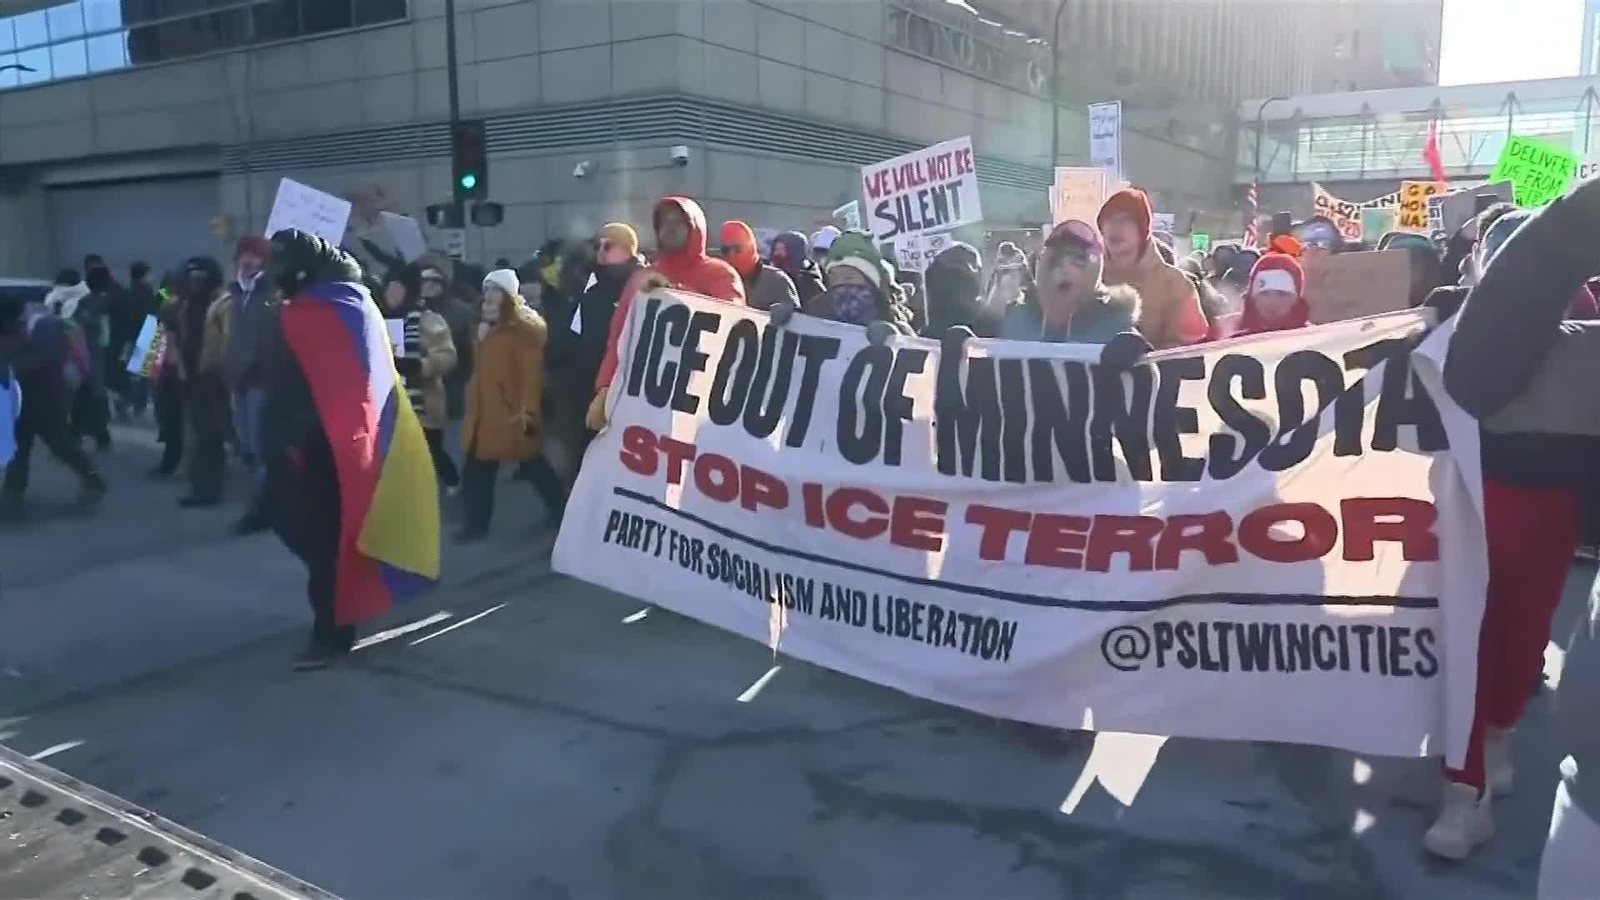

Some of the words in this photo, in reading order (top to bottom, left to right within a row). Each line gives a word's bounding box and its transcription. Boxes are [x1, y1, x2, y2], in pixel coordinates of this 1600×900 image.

[865, 168, 891, 199] WE
[892, 160, 927, 191] WILL
[926, 152, 952, 182] NOT
[953, 147, 974, 176] BE
[1509, 141, 1570, 177] DELIVER
[1522, 169, 1564, 196] FROM
[873, 180, 963, 241] SILENT
[627, 298, 721, 414] ICE
[708, 318, 841, 449] OUT
[836, 345, 929, 467] OF
[935, 336, 1450, 483] MINNESOTA
[619, 424, 789, 512] STOP
[802, 483, 950, 553] ICE
[965, 496, 1440, 573] TERROR
[603, 509, 668, 558] PARTY
[668, 530, 704, 574] FOR
[705, 543, 815, 616] SOCIALISM
[819, 582, 868, 628] AND
[871, 593, 1018, 663] LIBERATION
[1100, 620, 1440, 679] @PSLTWINCITIES
